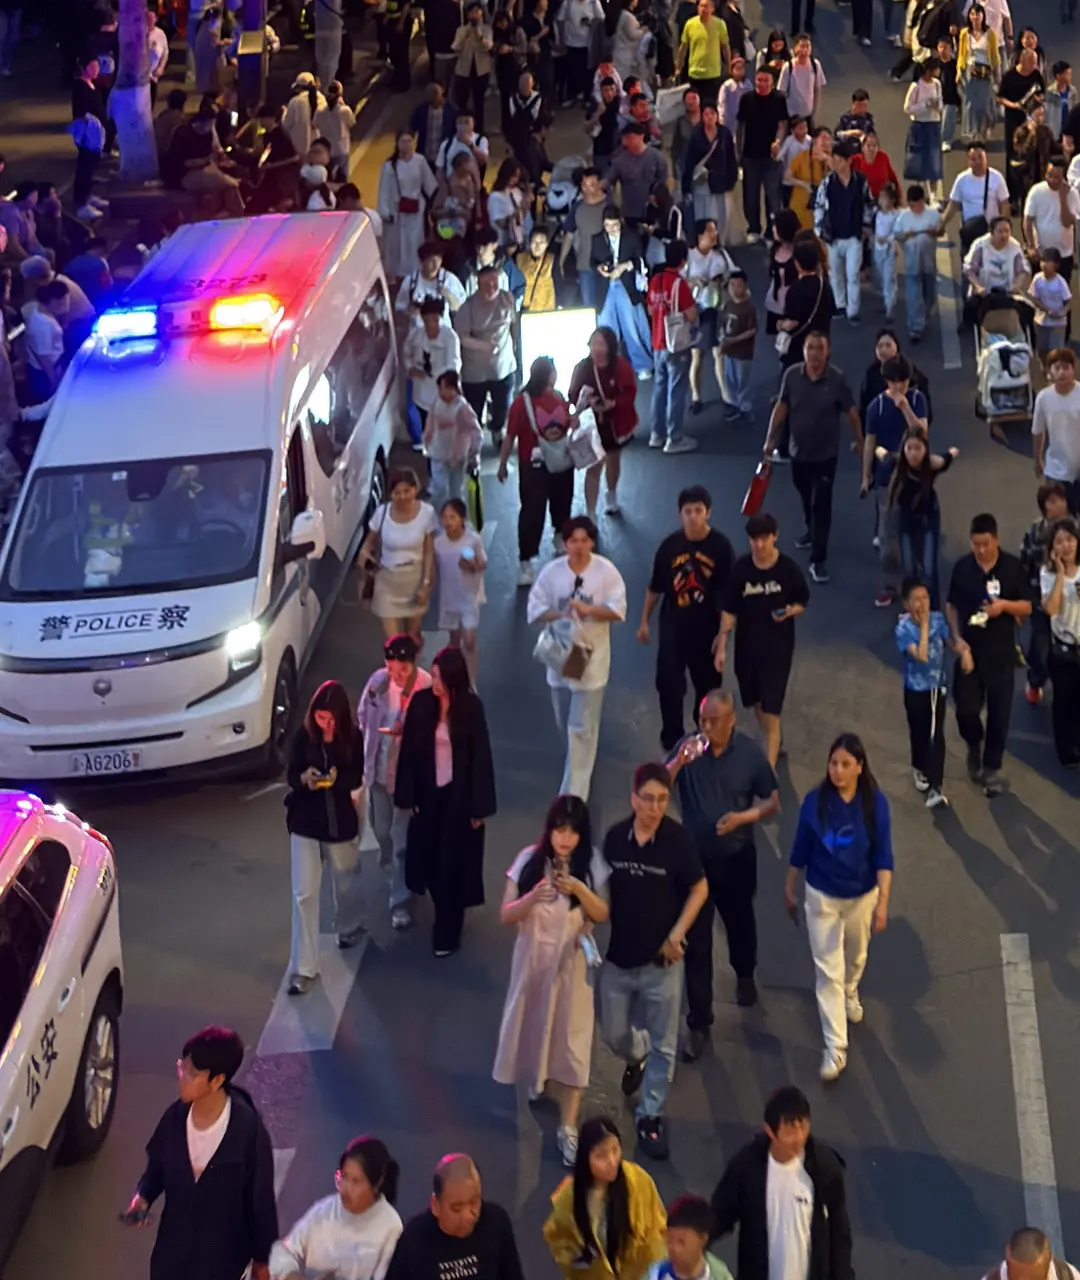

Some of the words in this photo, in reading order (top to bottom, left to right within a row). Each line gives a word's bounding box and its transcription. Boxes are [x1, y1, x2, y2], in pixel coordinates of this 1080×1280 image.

[74, 613, 152, 633] POLICE
[157, 605, 190, 630] 察
[26, 1017, 58, 1111] 公安
